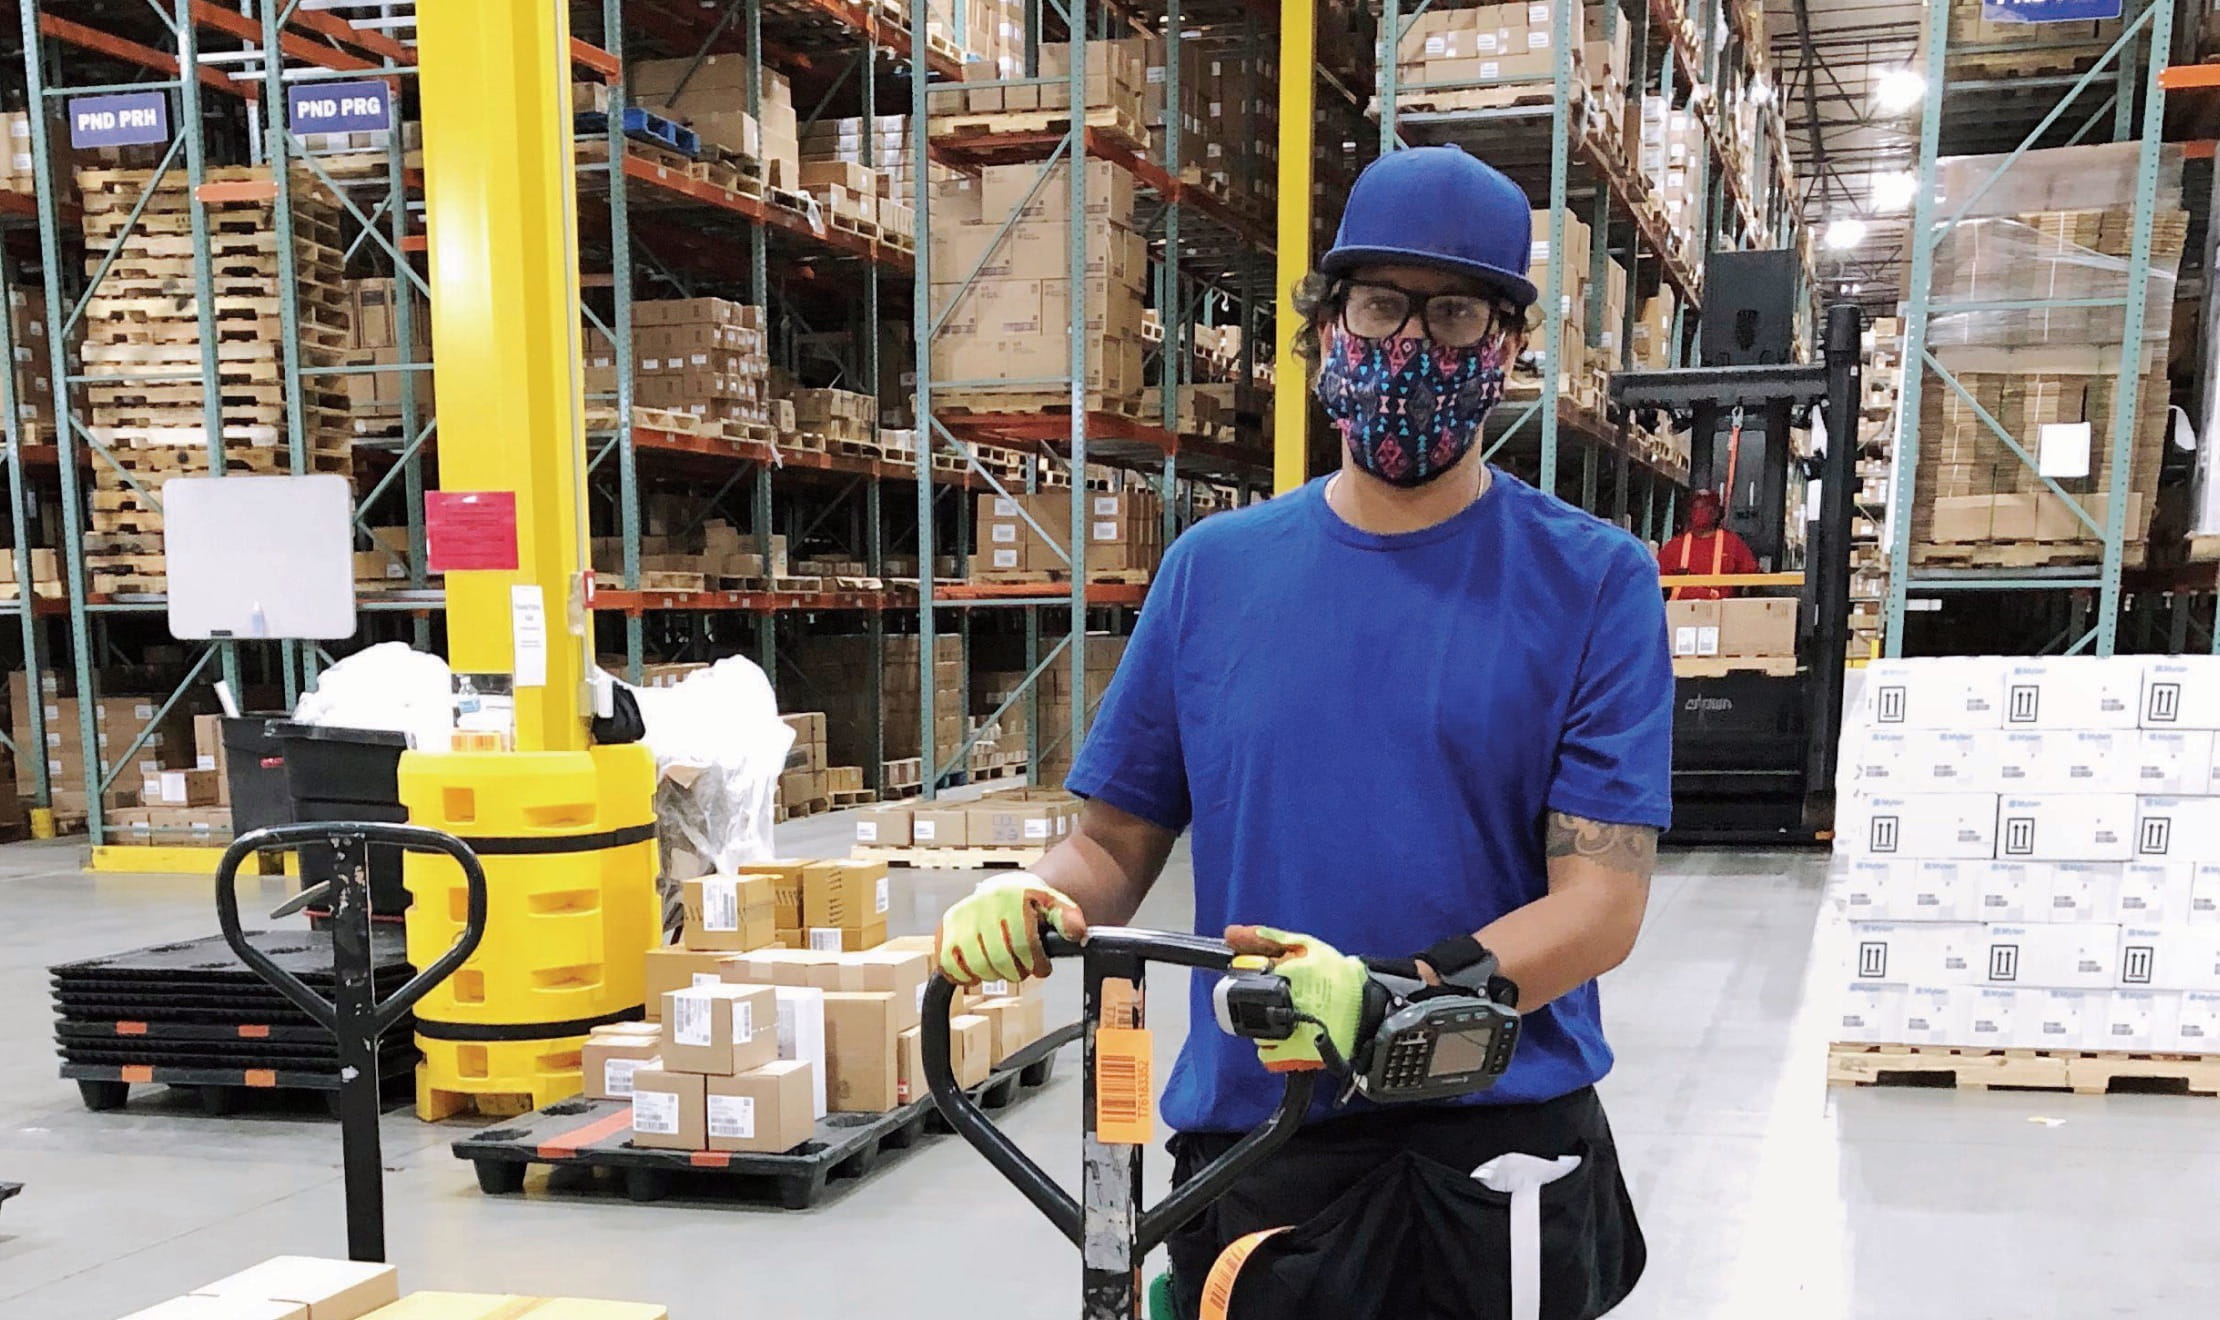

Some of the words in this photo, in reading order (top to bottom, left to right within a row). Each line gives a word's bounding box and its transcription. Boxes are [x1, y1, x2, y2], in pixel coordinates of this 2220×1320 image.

[297, 99, 337, 119] PND
[340, 96, 382, 117] PRG
[78, 111, 115, 132] PND
[119, 108, 157, 128] PRH
